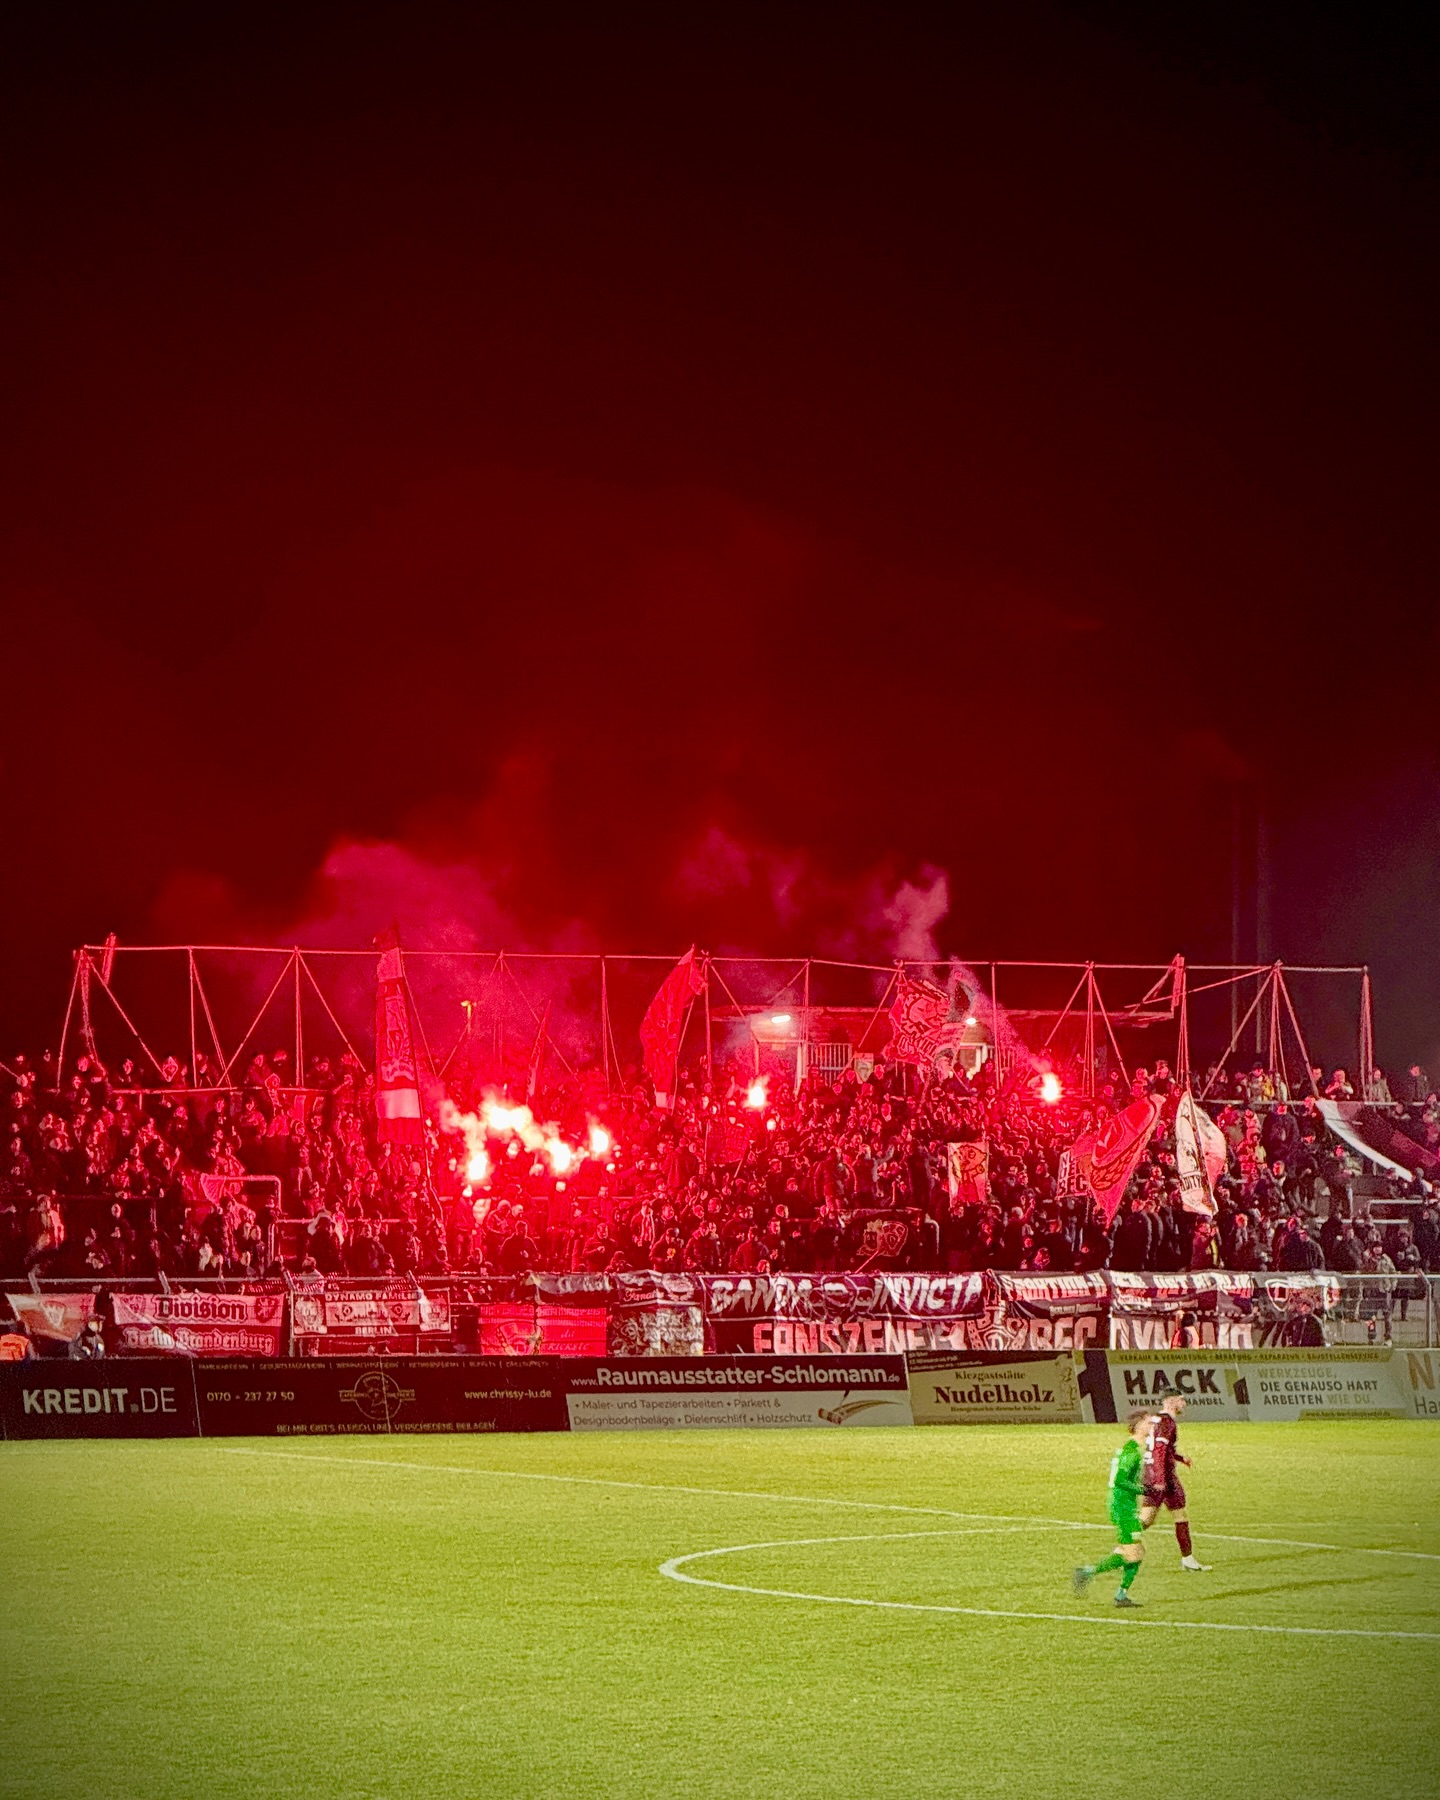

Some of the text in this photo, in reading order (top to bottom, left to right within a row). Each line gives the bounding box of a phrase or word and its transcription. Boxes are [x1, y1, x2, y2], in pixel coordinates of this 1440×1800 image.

[325, 1292, 373, 1302] DYNAMO
[709, 1274, 983, 1314] BANDA INVICTA
[154, 1296, 246, 1320] Division
[354, 1326, 392, 1336] BERLIN
[1029, 1316, 1097, 1351] BFC
[123, 1328, 275, 1354] Berlin Brandenburg
[955, 1369, 1026, 1382] Kiezgaststätte
[1407, 1352, 1440, 1390] N
[1123, 1369, 1221, 1395] HACK
[1260, 1380, 1378, 1392] DIE GENAUSO HART
[22, 1387, 177, 1414] KREDIT.DE
[207, 1391, 295, 1402] 0170 237 27 50
[464, 1389, 552, 1400] www.chrissy-lu.de
[933, 1384, 1055, 1404] Nudelholz
[1263, 1394, 1323, 1405] ARBEITEN
[1327, 1394, 1350, 1405] WIE
[582, 1399, 781, 1411] Maler- und Tapezierarbeiten Parkett &
[1129, 1397, 1225, 1406] WERKZHANDEL
[1414, 1396, 1440, 1414] Ha
[573, 1413, 813, 1427] Designbodenbeläge Dielenschliff Holzschutz
